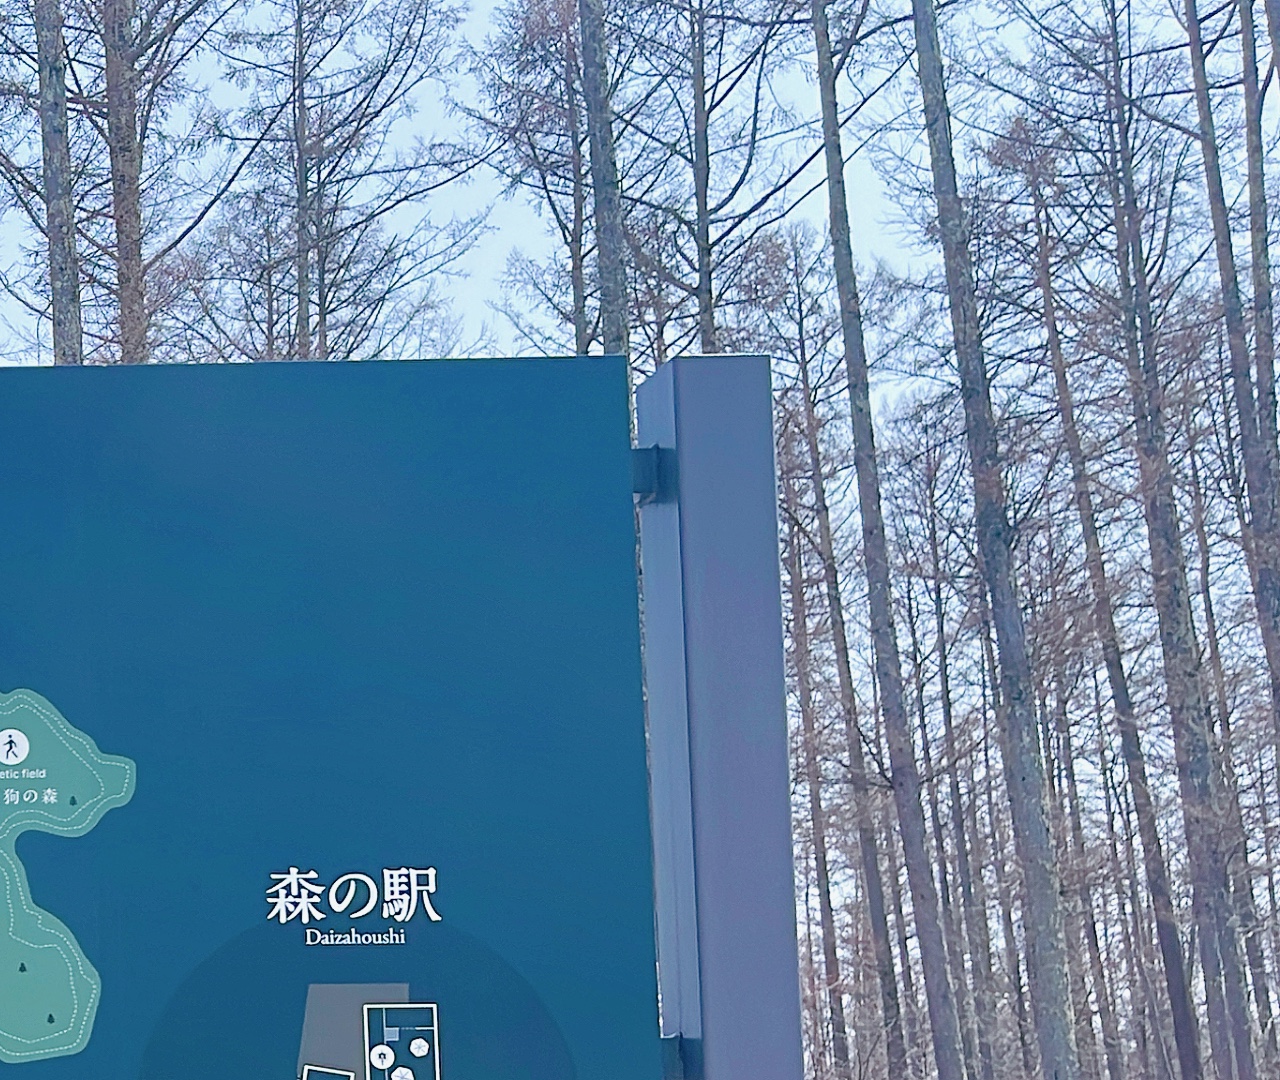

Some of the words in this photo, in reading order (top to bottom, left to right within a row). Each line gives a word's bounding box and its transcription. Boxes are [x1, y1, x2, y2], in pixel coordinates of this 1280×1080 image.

[22, 769, 46, 778] field
[266, 867, 442, 924] 森の駅
[306, 928, 405, 945] Daizahoushi
